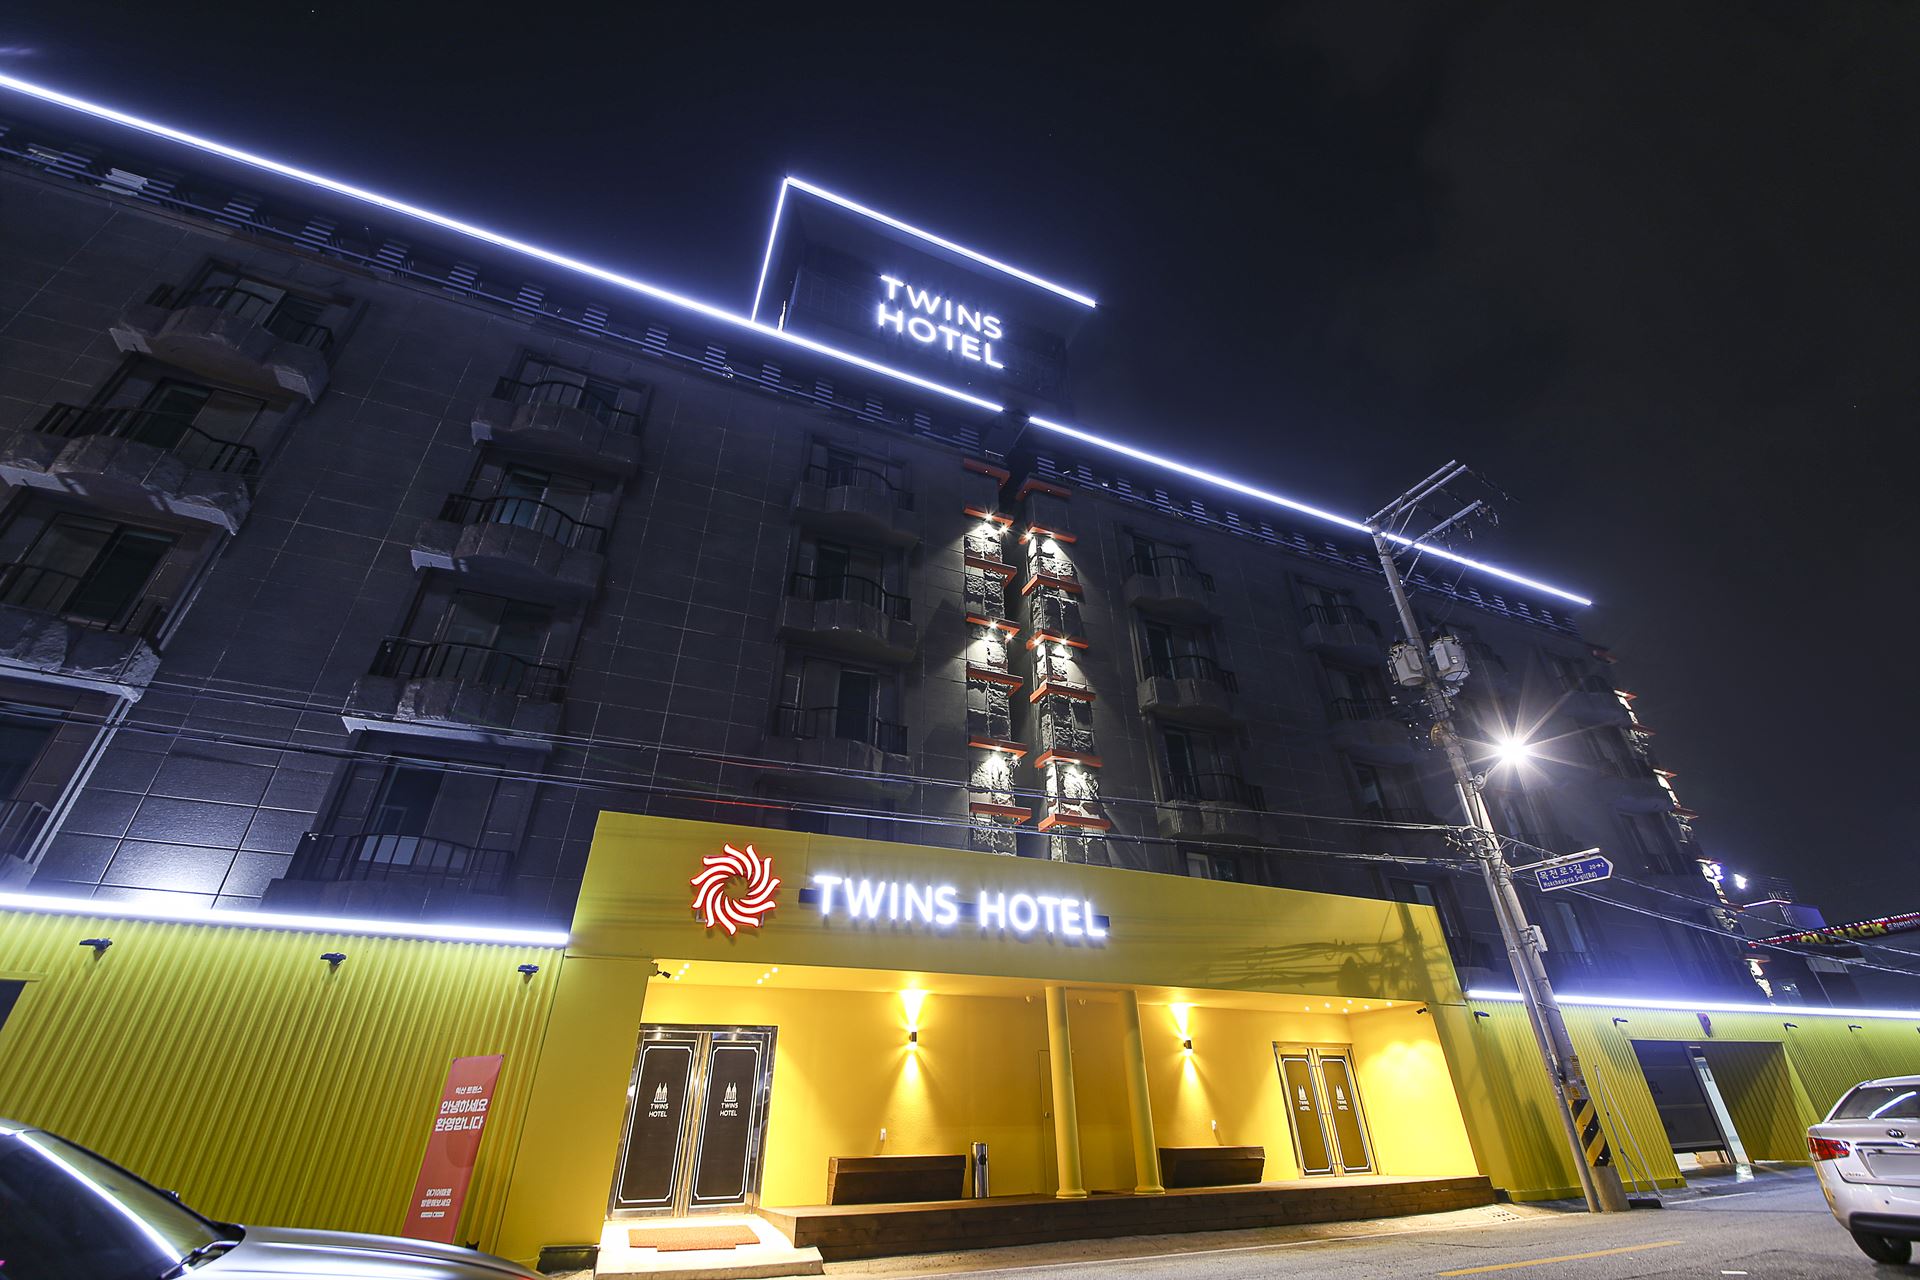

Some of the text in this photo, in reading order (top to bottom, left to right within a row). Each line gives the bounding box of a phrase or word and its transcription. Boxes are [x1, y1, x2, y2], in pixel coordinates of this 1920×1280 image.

[880, 274, 1002, 339] TWINS
[878, 303, 1004, 369] HOTEL
[813, 875, 1107, 937] TWINS HOTEL
[440, 1098, 489, 1114] 안녕하세요
[648, 1110, 668, 1118] HOTEL
[719, 1109, 738, 1117] HOTEL
[435, 1116, 484, 1131] 환영합니다
